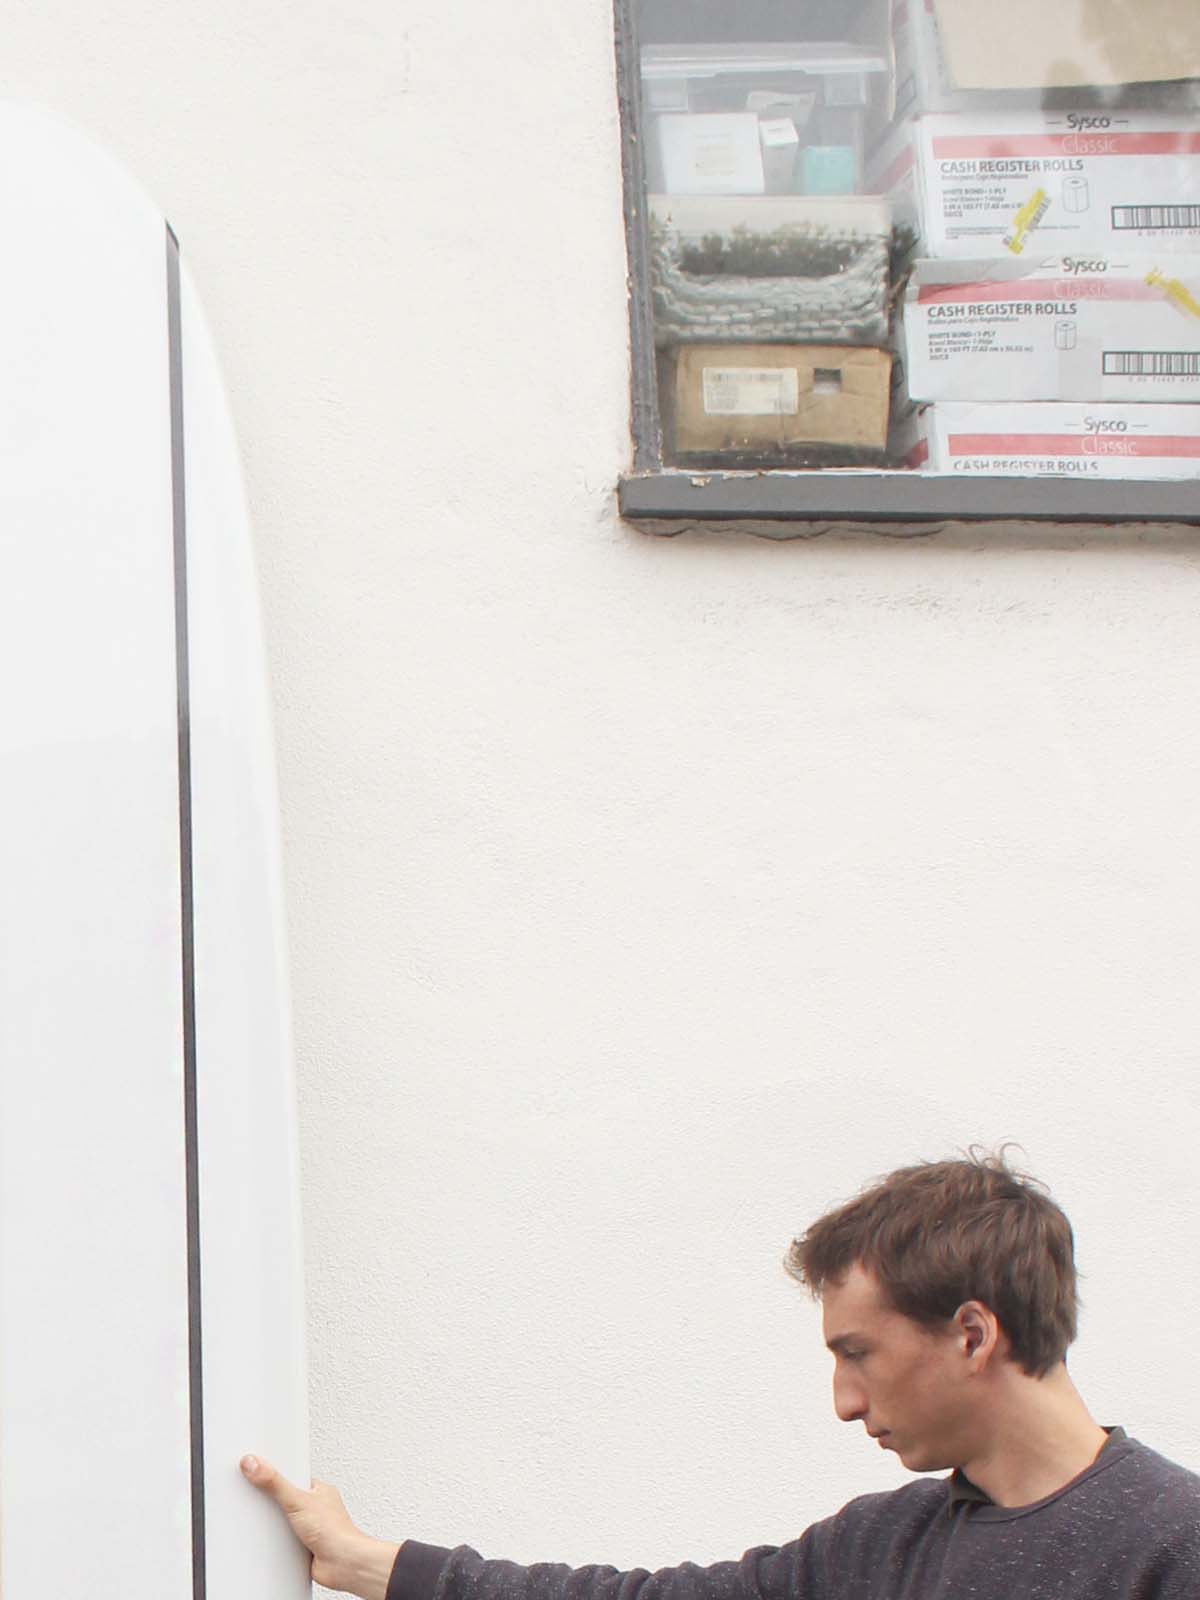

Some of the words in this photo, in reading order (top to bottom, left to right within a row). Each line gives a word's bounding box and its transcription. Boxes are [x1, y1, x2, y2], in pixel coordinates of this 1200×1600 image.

[1066, 113, 1111, 131] Sysco
[1061, 135, 1118, 154] Classic
[940, 161, 977, 174] CASH
[979, 160, 1041, 173] REGISTER
[1043, 159, 1085, 171] ROLLS
[1062, 257, 1107, 275] Sysco
[927, 305, 965, 318] CASH
[968, 303, 1033, 316] REGISTER
[1035, 303, 1077, 315] ROLLS
[1083, 417, 1127, 434] Sysco
[1081, 437, 1138, 456] Classic
[953, 460, 990, 471] CASH
[992, 460, 1057, 472] REGISTER
